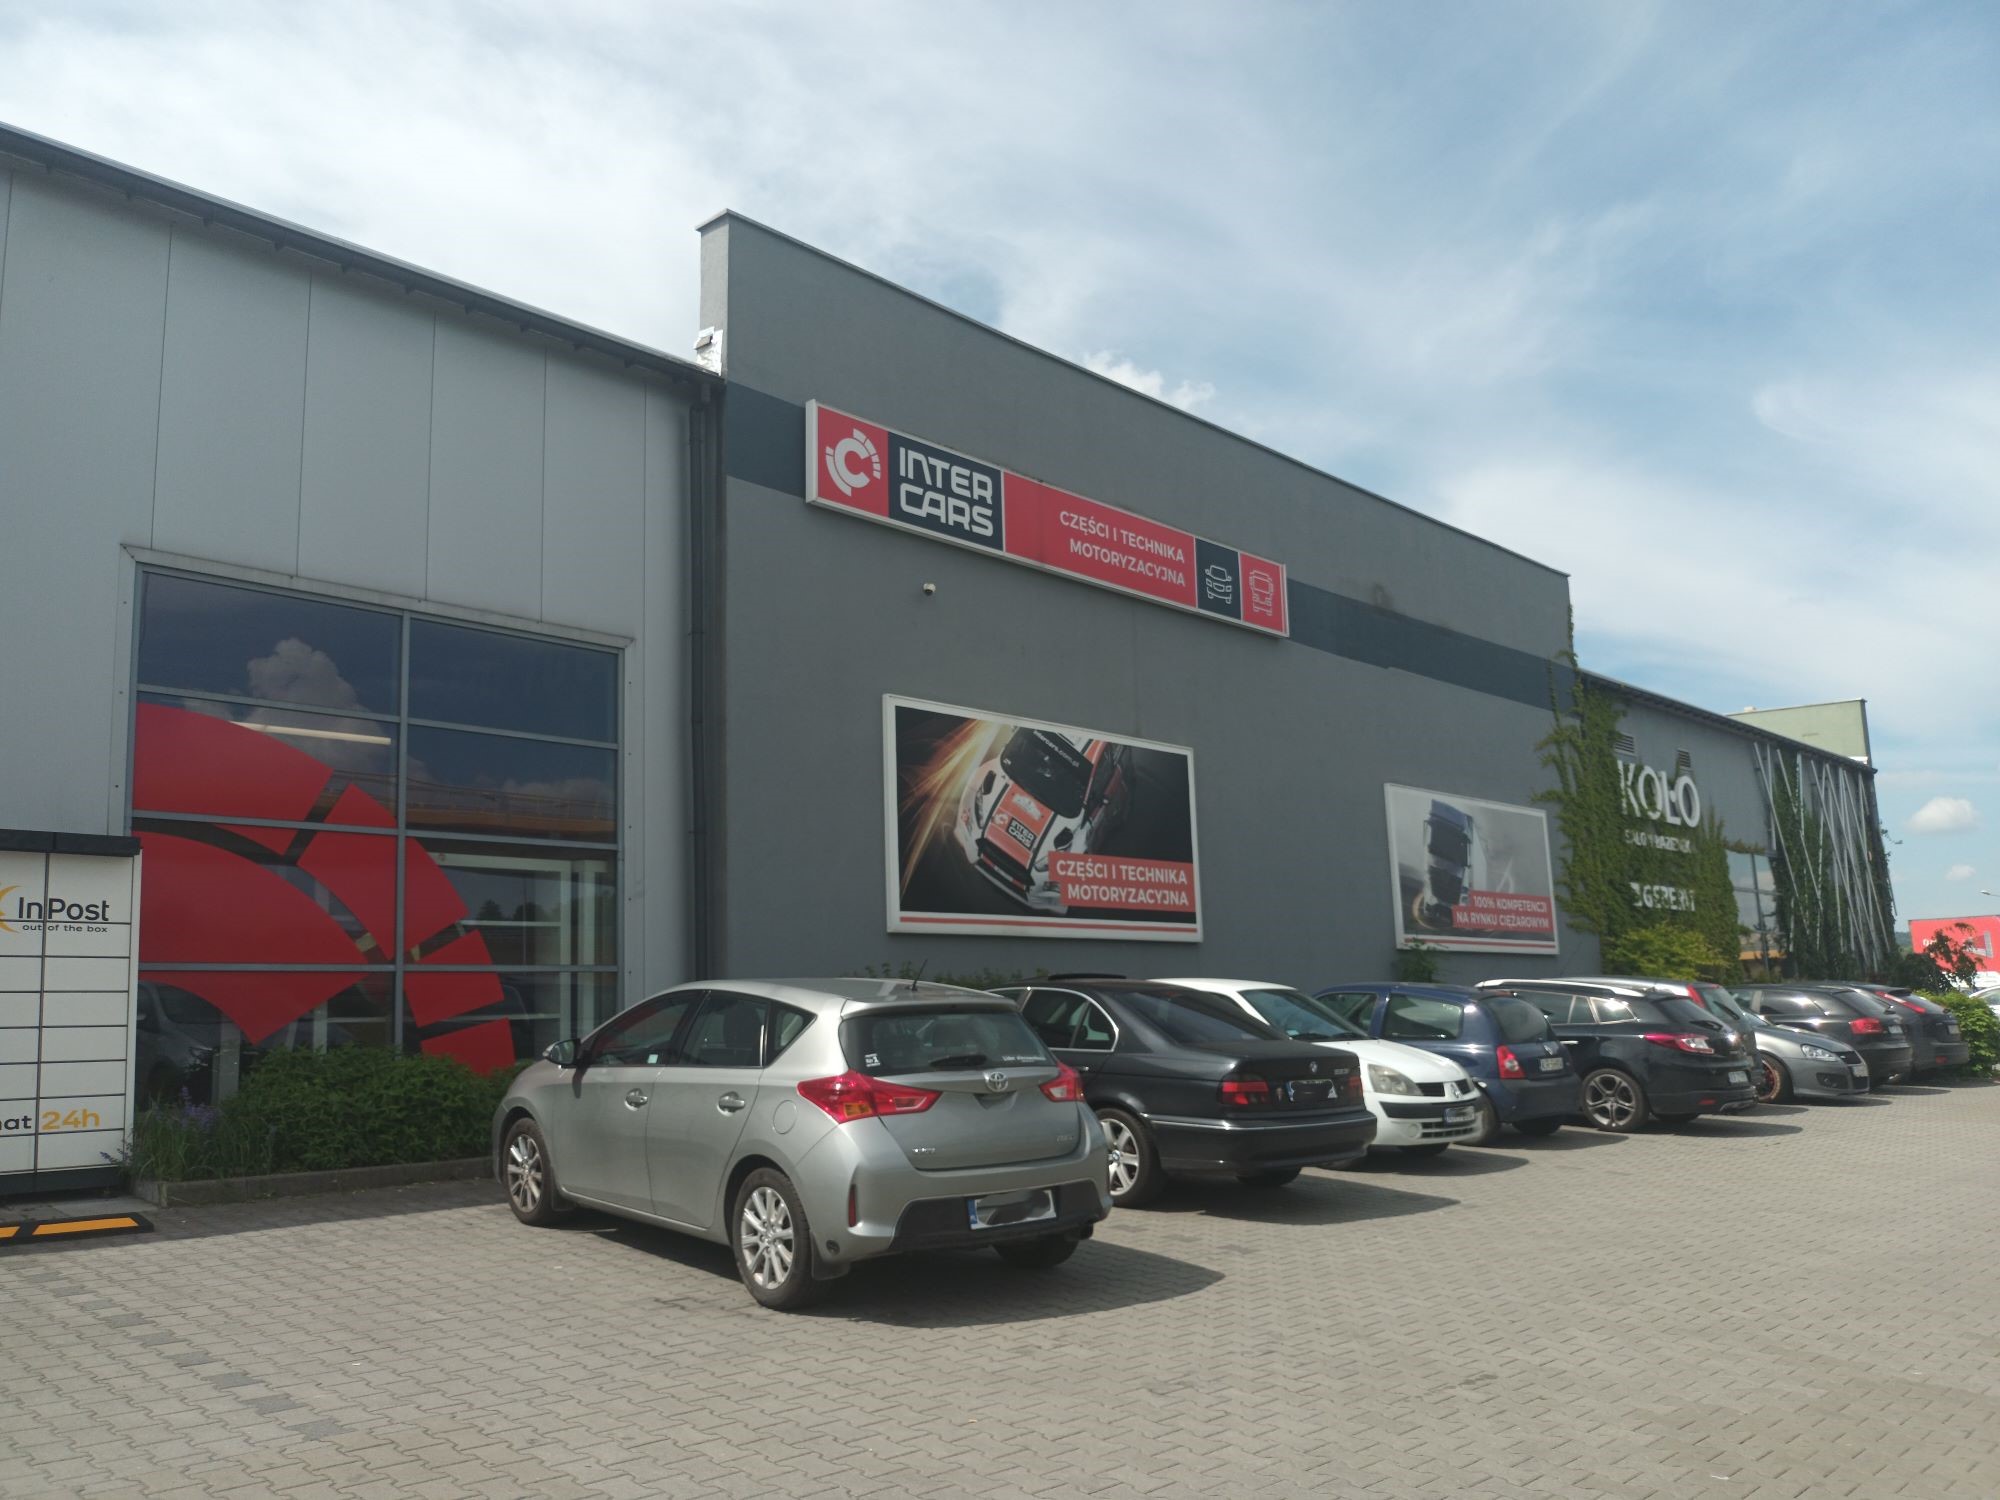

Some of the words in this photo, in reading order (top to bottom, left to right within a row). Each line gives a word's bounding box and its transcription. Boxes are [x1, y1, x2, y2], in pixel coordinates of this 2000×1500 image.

[899, 446, 993, 505] INTER
[900, 482, 994, 537] CARS
[1060, 511, 1109, 539] CZĘŚCI
[1113, 527, 1118, 542] I
[1120, 529, 1185, 564] TECHNIKA
[1069, 538, 1186, 588] MOTORYZACYJNA
[1056, 858, 1108, 881] CZĘŚCI
[1112, 864, 1116, 879] I
[1120, 865, 1187, 885] TECHNIKA
[1067, 883, 1189, 906] MOTORYZACYJNA
[19, 897, 110, 921] InPost
[1456, 911, 1469, 924] NA
[63, 924, 83, 932] the
[86, 924, 108, 933] box
[0, 1115, 33, 1131] at
[41, 1108, 101, 1132] 24h
